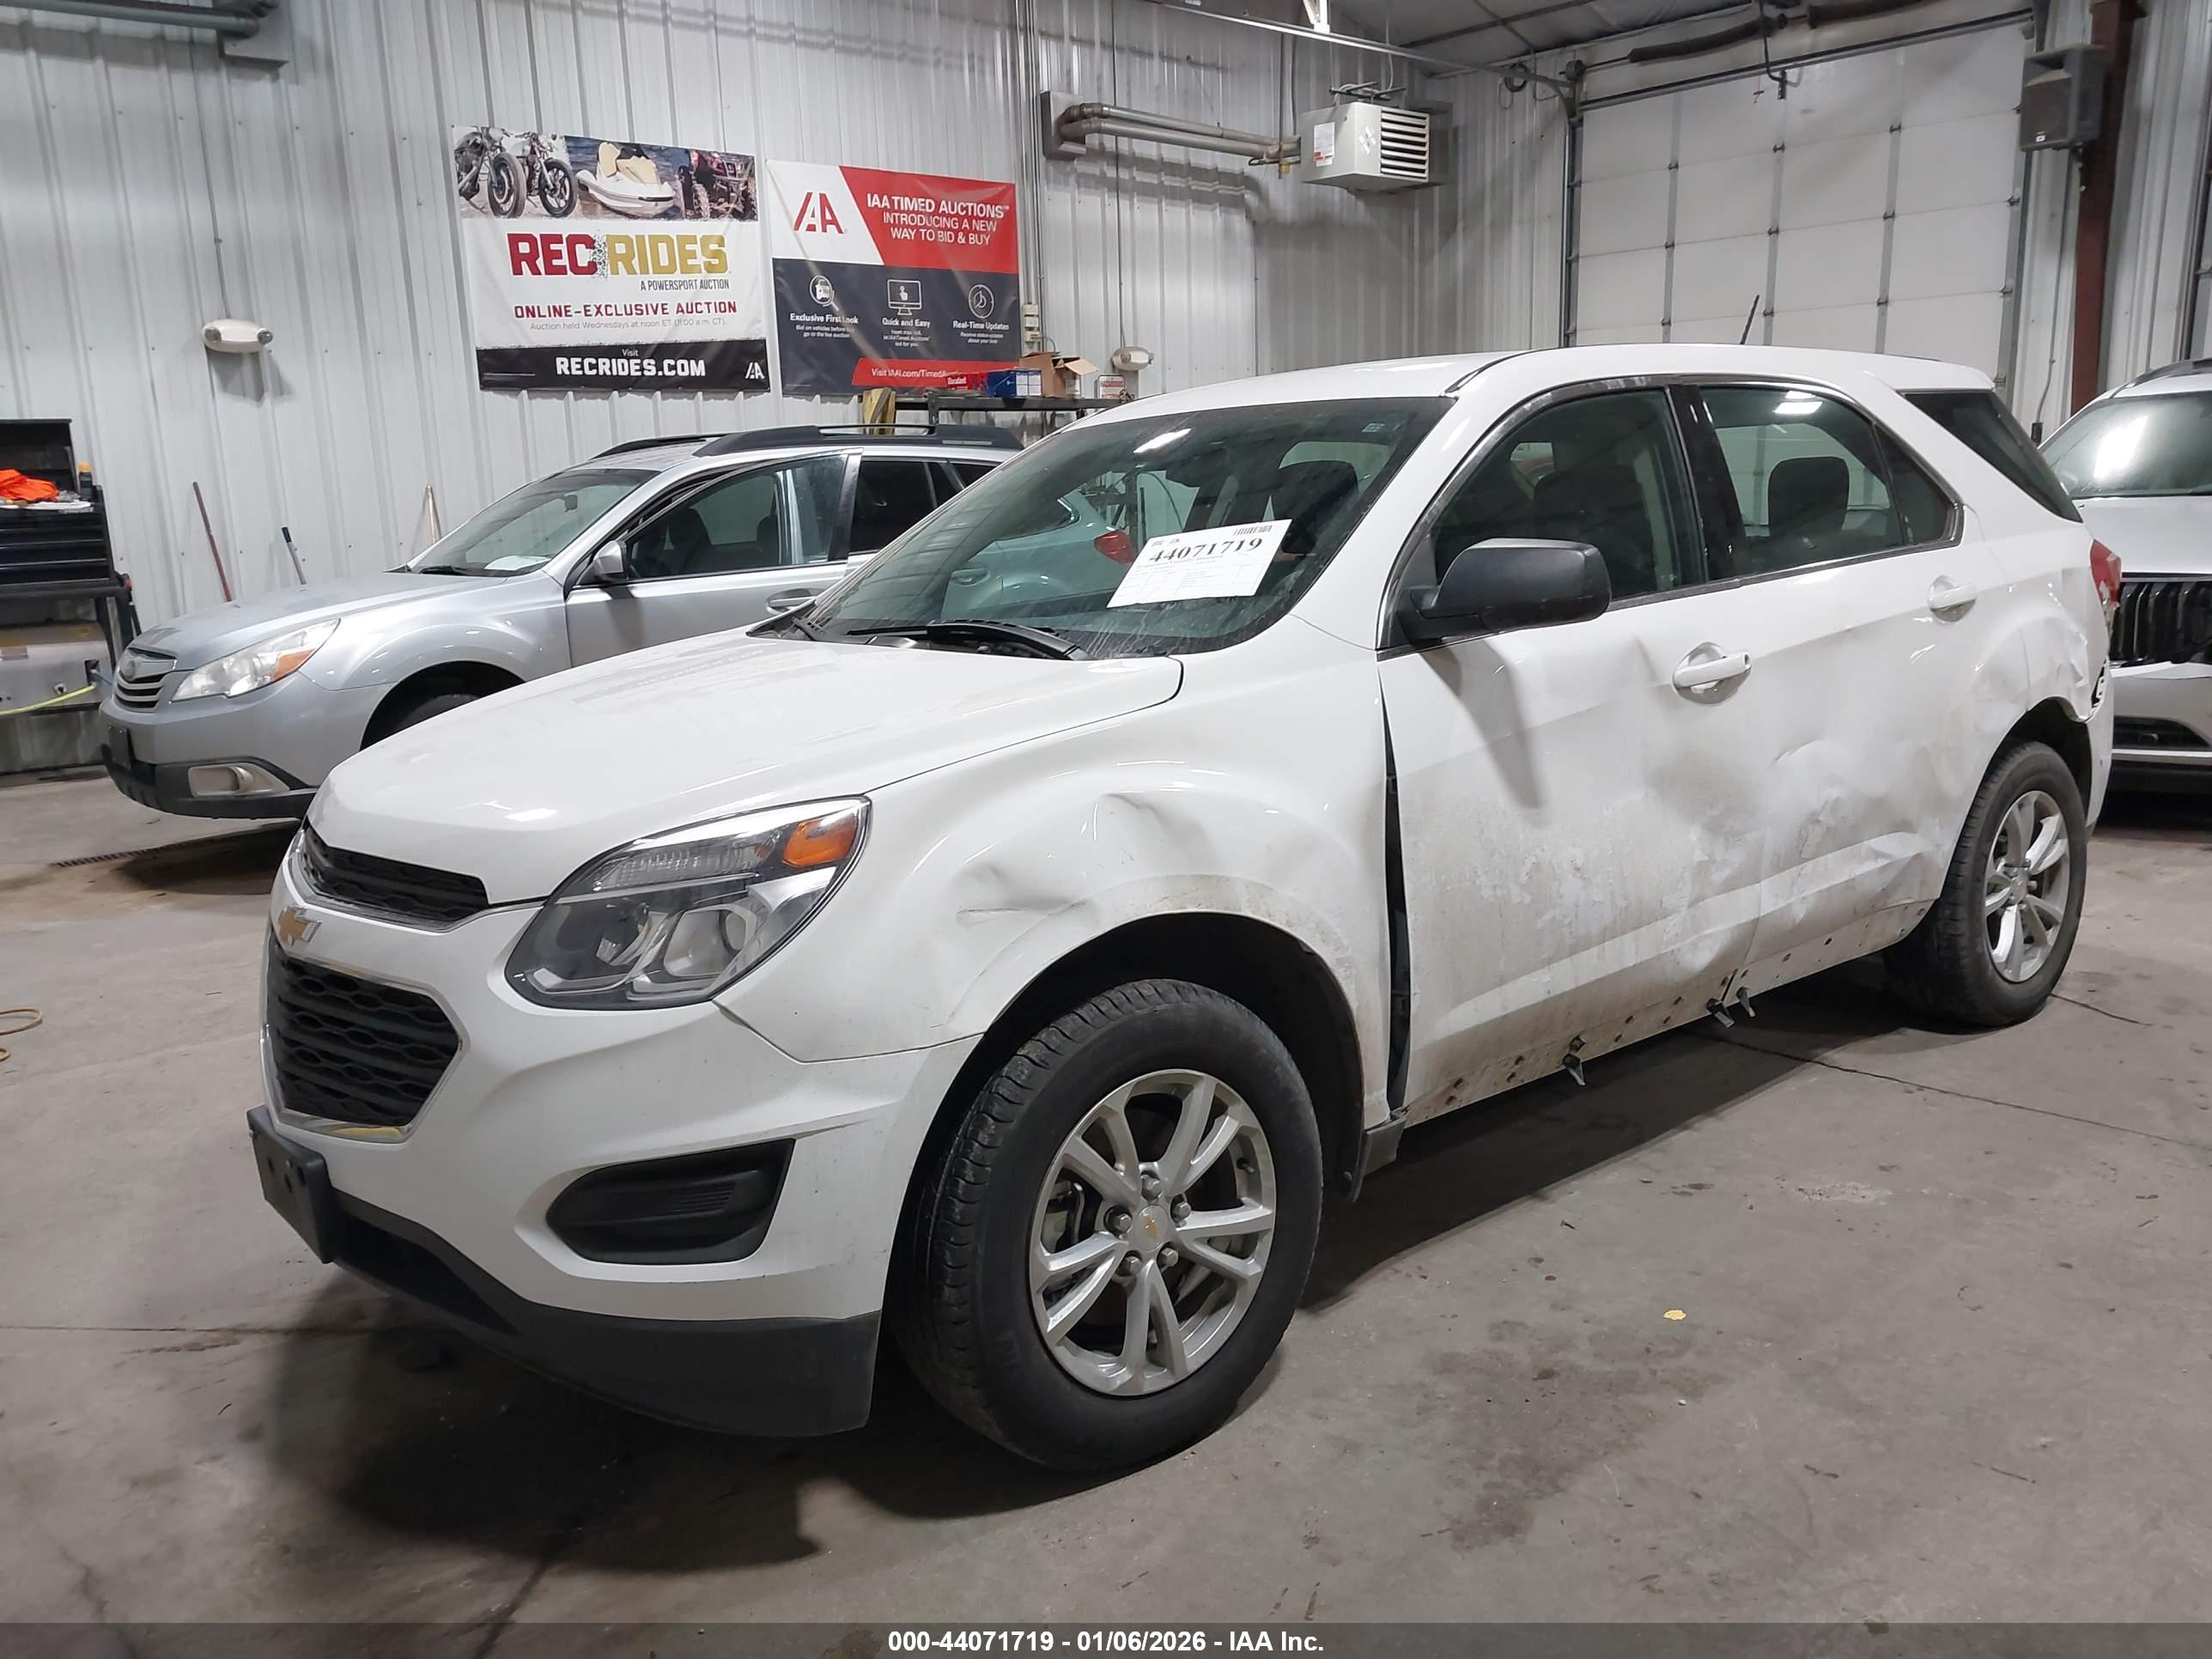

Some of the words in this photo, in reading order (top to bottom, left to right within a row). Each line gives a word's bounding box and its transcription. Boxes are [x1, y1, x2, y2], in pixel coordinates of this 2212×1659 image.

[866, 193, 890, 210] IAA
[892, 195, 935, 212] TIMED
[883, 212, 958, 229] INTRODUCING
[962, 220, 970, 230] A
[972, 220, 997, 233] NEW
[890, 228, 915, 240] WAY
[920, 229, 935, 241] TO
[937, 231, 954, 244] BID
[957, 232, 966, 244] &
[968, 233, 991, 246] BUY
[507, 233, 599, 276] REC
[607, 234, 728, 276] RIDES
[640, 280, 646, 291] A
[648, 279, 699, 291] POWERSPORT
[699, 278, 729, 290] AUCTION
[514, 302, 670, 319] ONLINE-EXCLUSIVE
[676, 301, 737, 314] AUCTION
[530, 322, 561, 331] Auction
[582, 321, 629, 331] Wednesdays
[790, 313, 824, 323] Exclusive
[825, 314, 842, 324] First
[842, 315, 859, 325] Look
[882, 318, 899, 326] Quick
[900, 319, 913, 327] and
[914, 319, 931, 329] Easy
[953, 320, 985, 330] Real-Time
[985, 322, 1010, 331] Updates
[622, 349, 639, 357] Visit
[556, 356, 706, 377] RECRIDES.COM
[872, 368, 887, 377] Visit
[1149, 538, 1263, 562] 44071719
